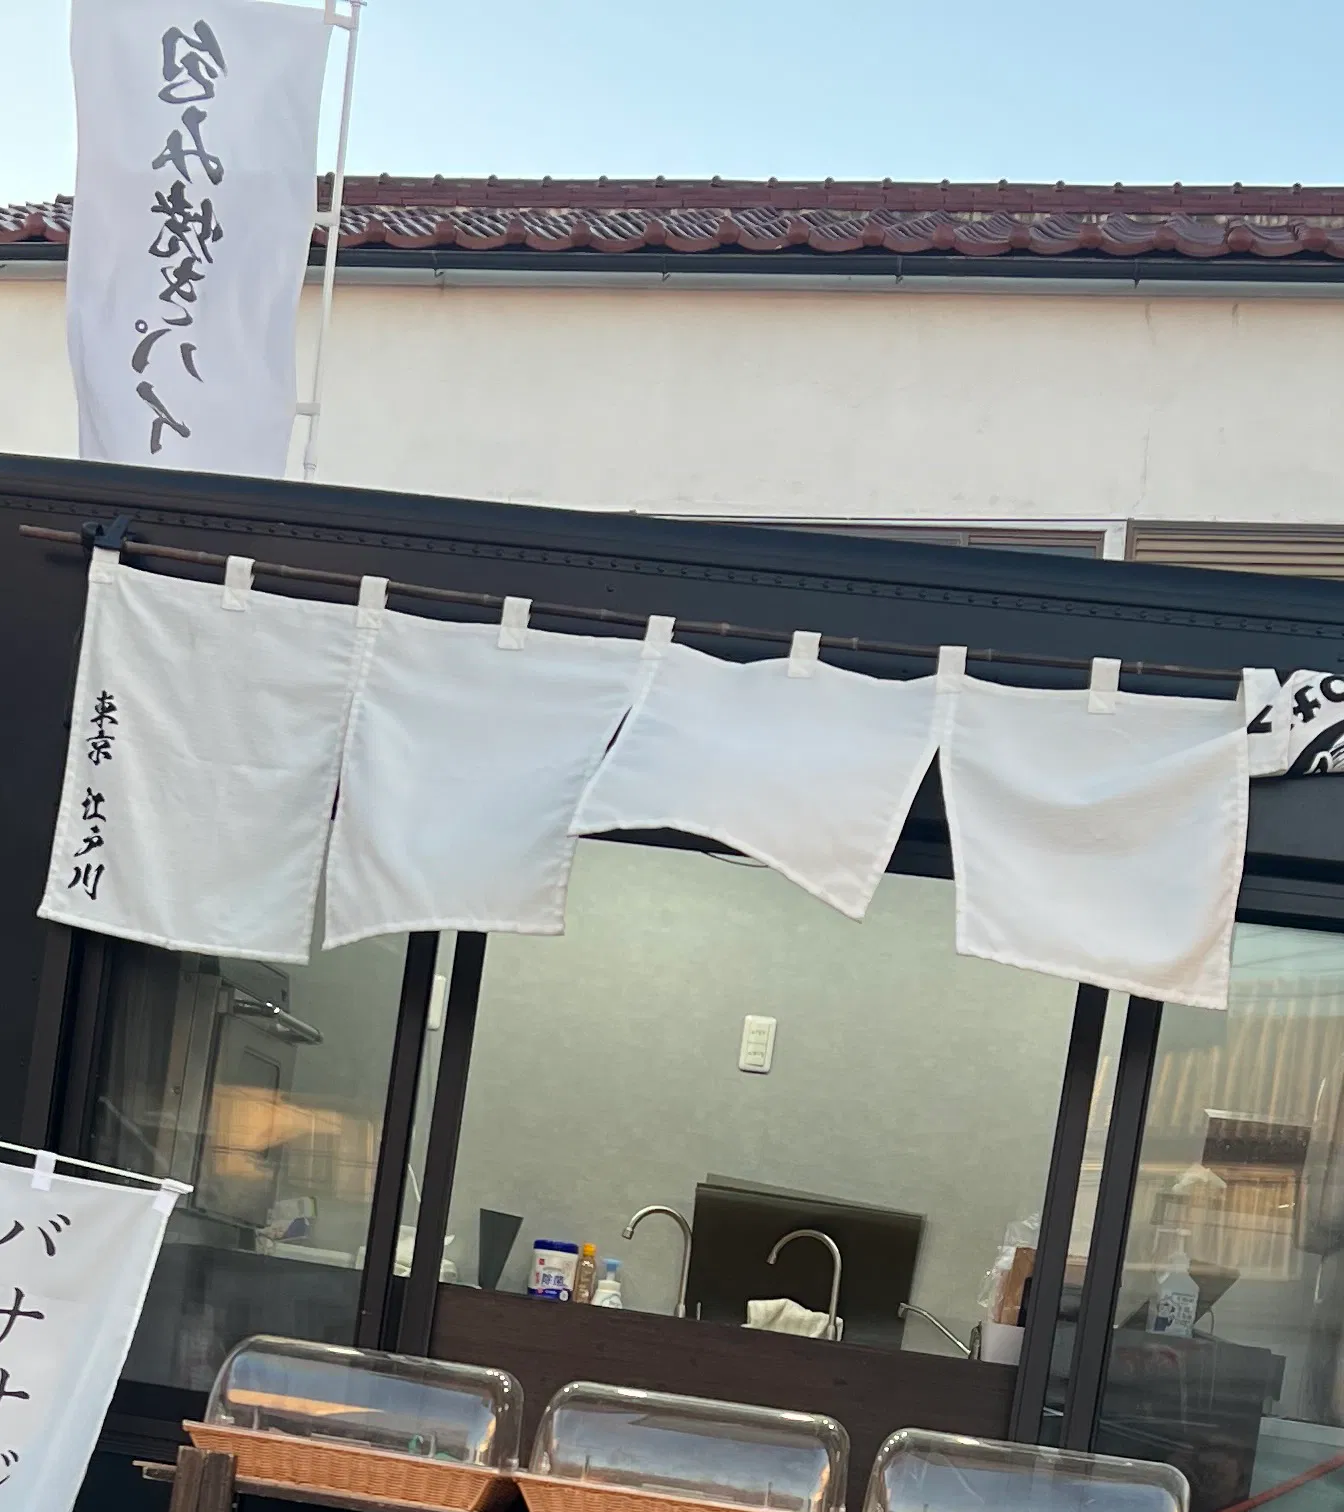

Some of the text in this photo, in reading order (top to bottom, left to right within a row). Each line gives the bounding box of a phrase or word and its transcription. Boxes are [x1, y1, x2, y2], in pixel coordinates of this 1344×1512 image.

[67, 690, 119, 900] 東京 江戸川
